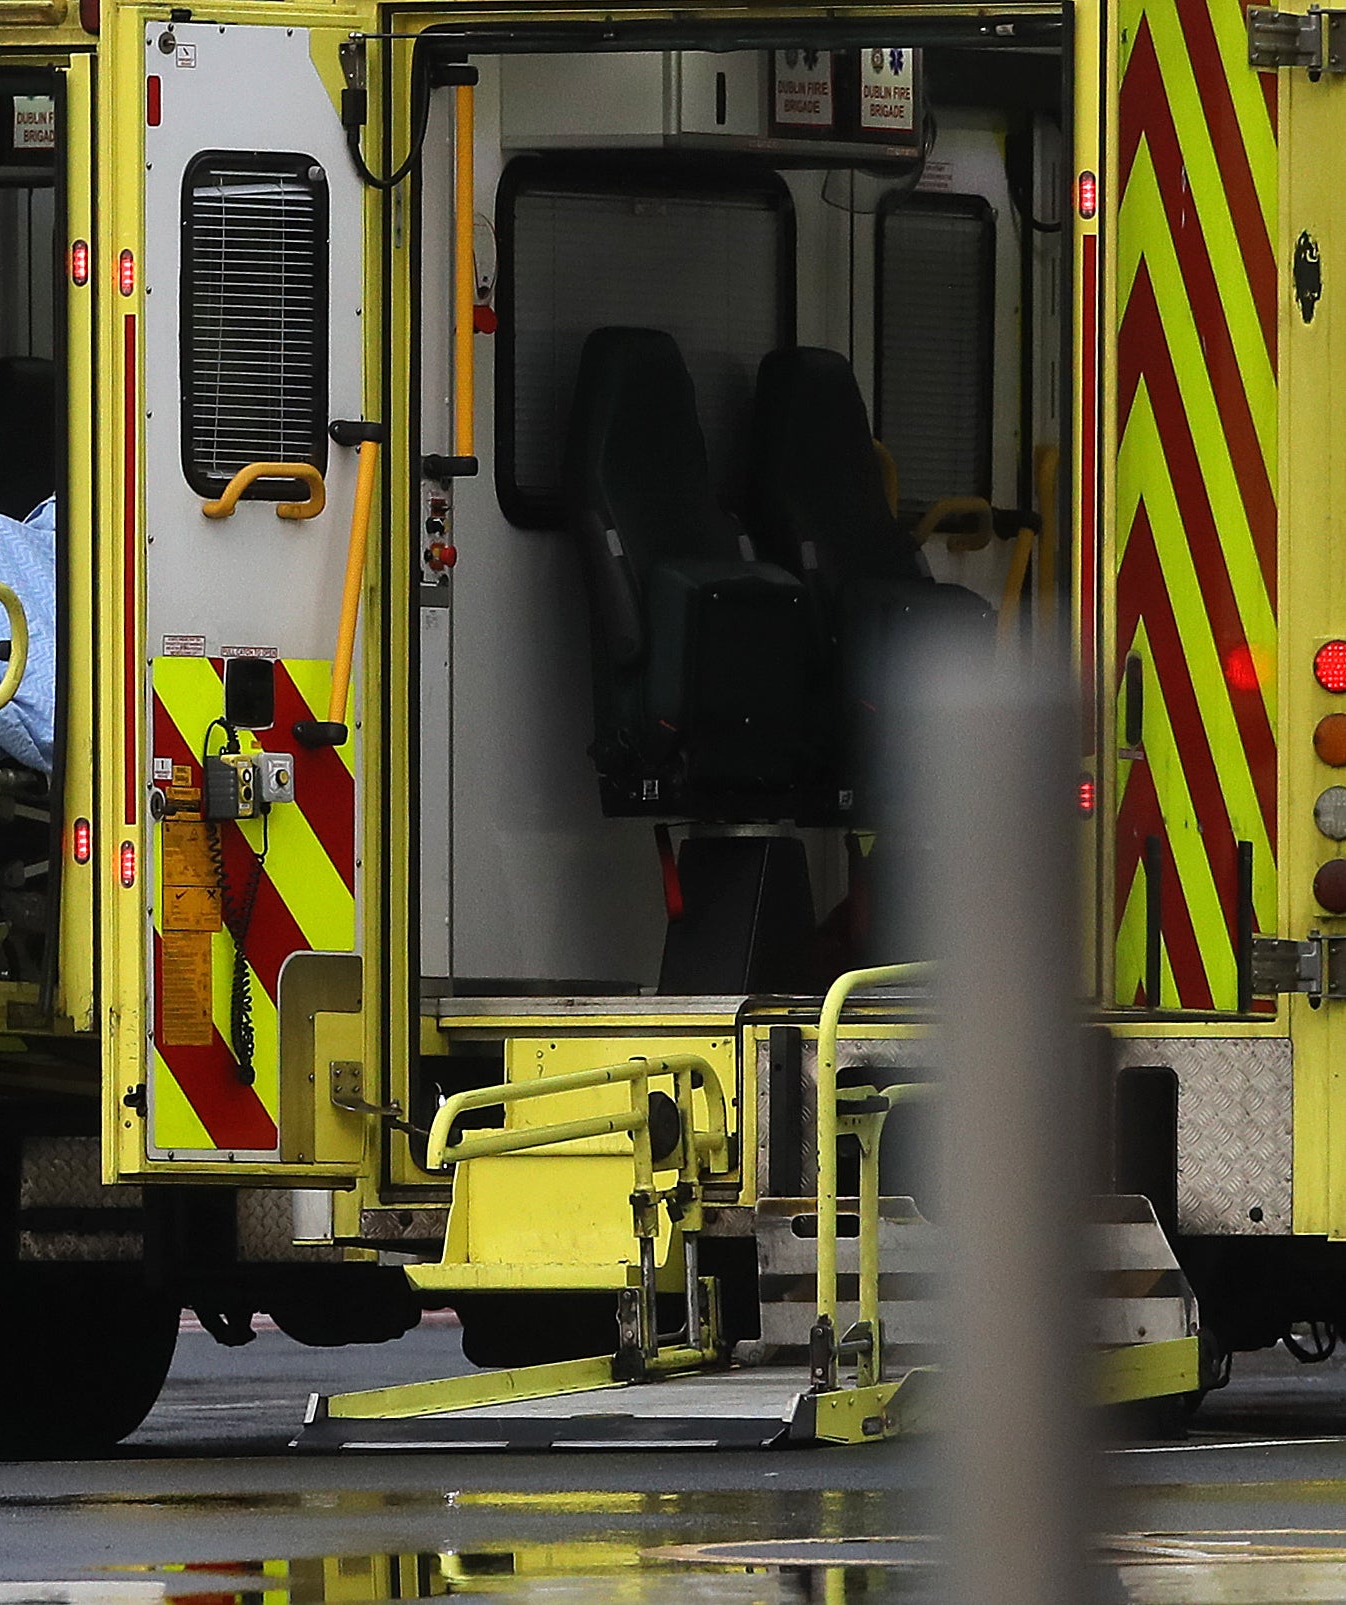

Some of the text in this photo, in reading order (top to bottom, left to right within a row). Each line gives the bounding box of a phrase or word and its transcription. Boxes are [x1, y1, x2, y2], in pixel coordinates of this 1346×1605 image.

[777, 80, 829, 96] DUBLIN FIRE
[863, 85, 911, 101] DUBLIN FIRE
[784, 99, 820, 114] BRIGADE
[870, 104, 905, 119] BRIGADE
[16, 112, 48, 125] DUBLIN
[23, 130, 54, 142] BRIGAD
